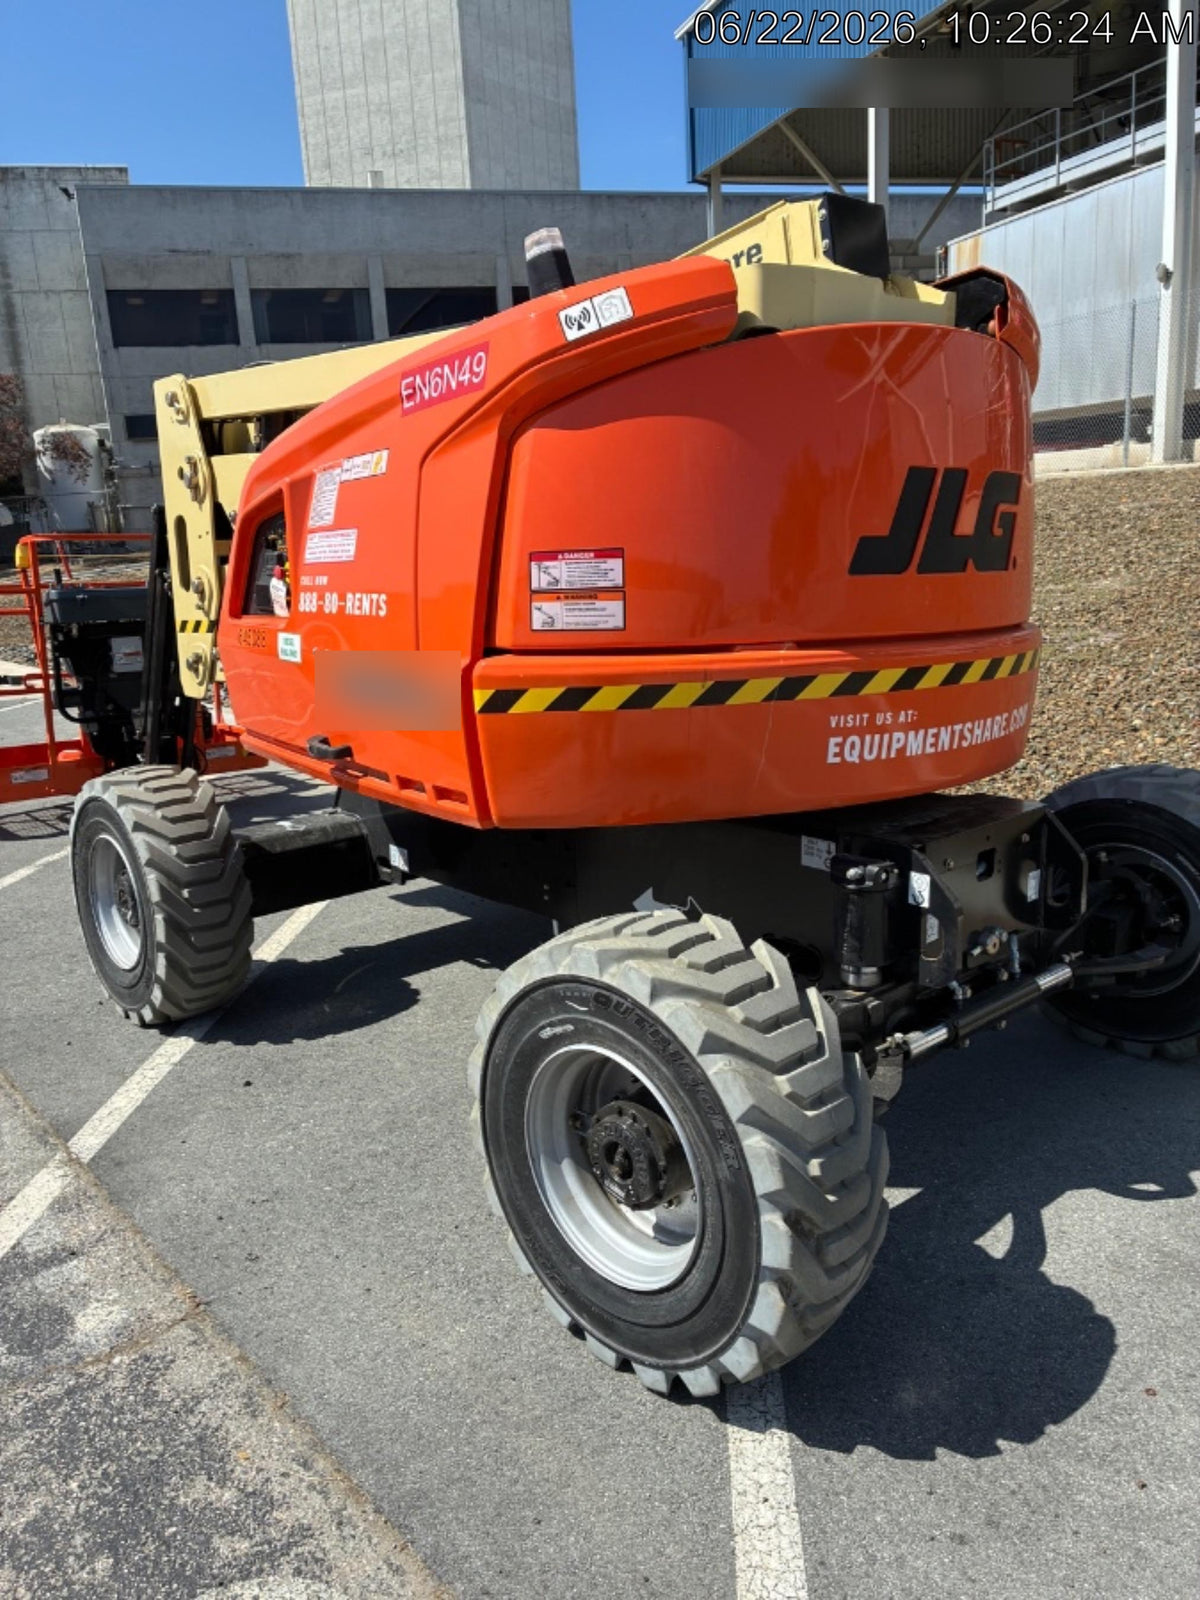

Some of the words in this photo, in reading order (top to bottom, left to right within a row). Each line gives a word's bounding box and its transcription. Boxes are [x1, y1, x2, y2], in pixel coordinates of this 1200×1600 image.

[400, 350, 487, 409] EN6N49
[847, 465, 1022, 575] JLG
[298, 591, 387, 616] 888-80-RENTS
[826, 703, 1030, 764] EQUIPMENTSHARE.COM
[829, 713, 869, 728] VISIT
[875, 711, 893, 726] US
[898, 709, 919, 724] AT:
